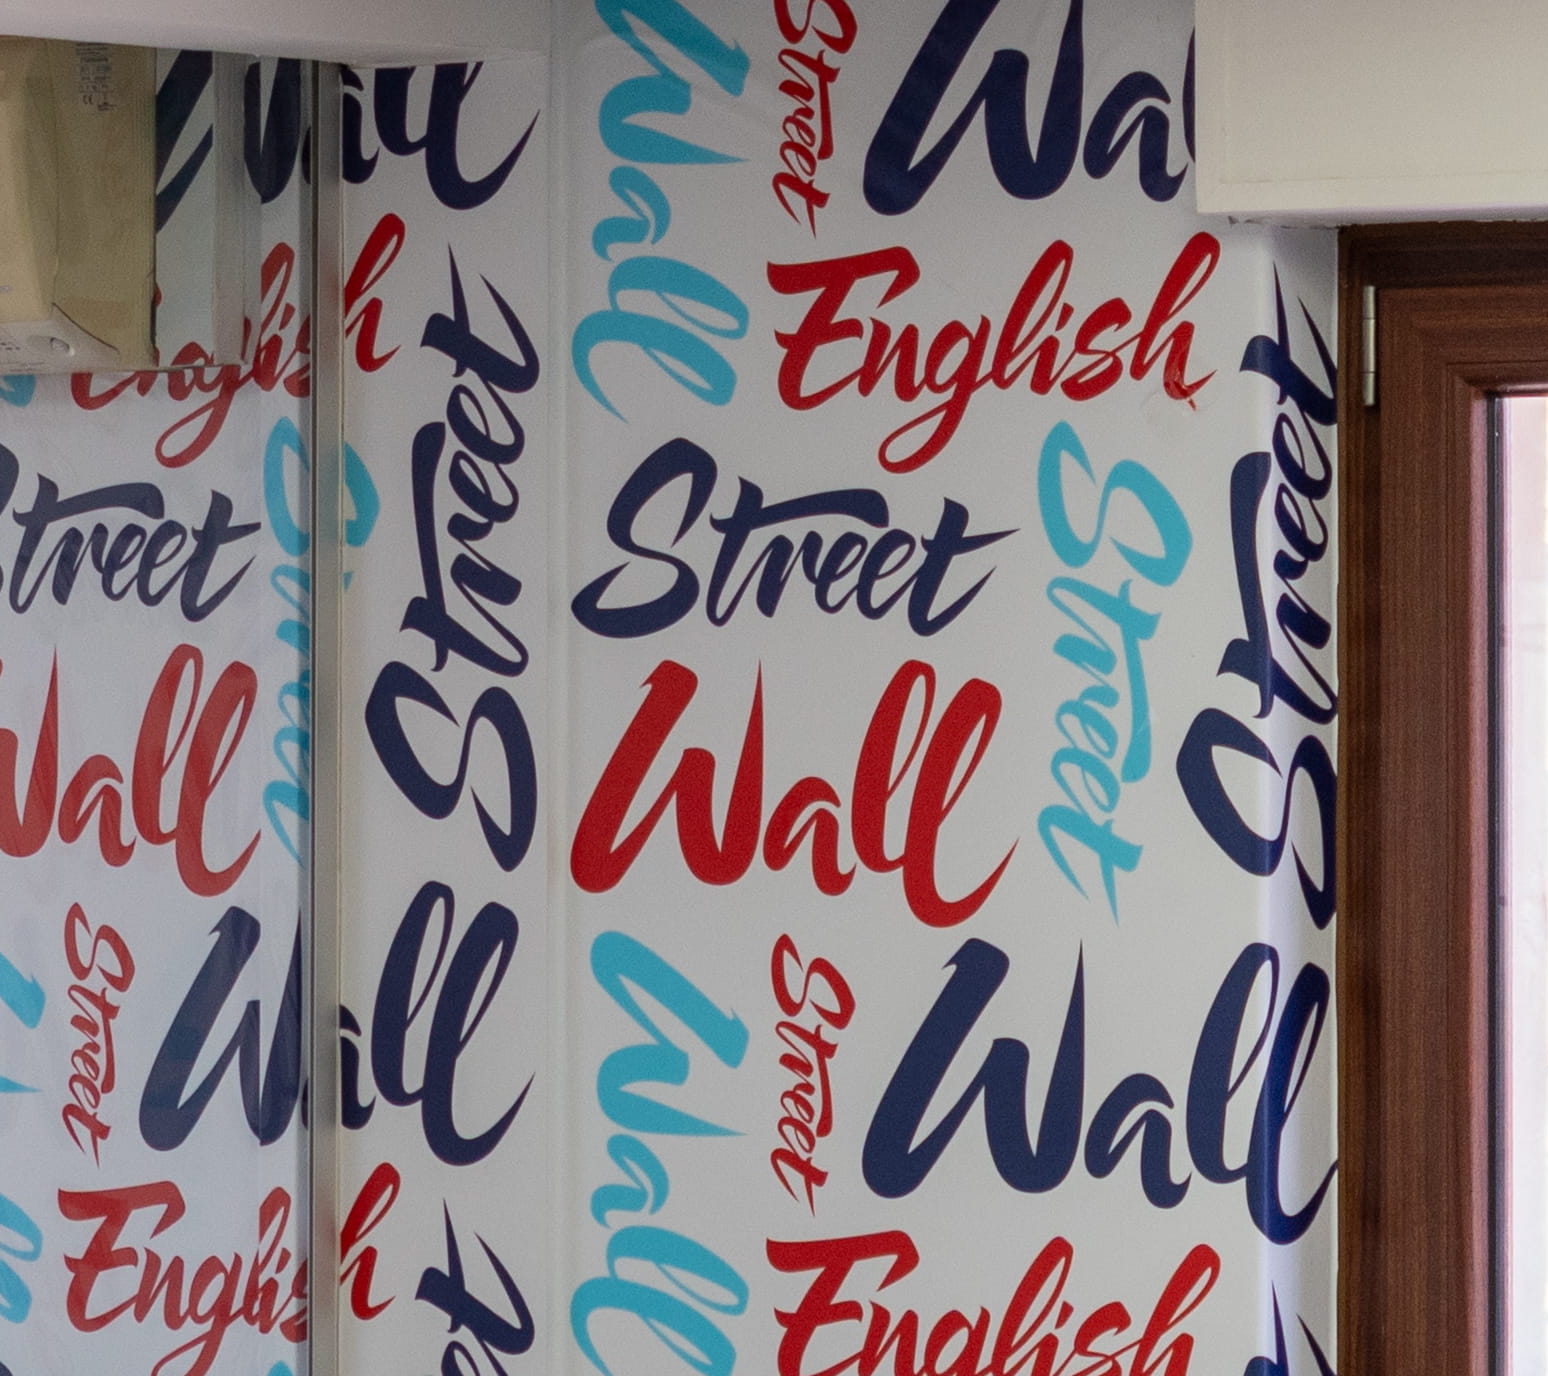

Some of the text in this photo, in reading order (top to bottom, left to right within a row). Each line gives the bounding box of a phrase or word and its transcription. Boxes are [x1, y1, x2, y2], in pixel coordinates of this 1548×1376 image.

[571, 0, 752, 424] Wall
[767, 231, 1222, 474] English
[364, 243, 541, 873] Street
[570, 437, 1020, 639] Street
[1036, 420, 1194, 926] Street
[1175, 260, 1337, 932] Street
[570, 659, 1019, 929] Wall
[64, 901, 136, 1168] Street
[770, 932, 856, 1217] Street
[861, 937, 1337, 1246] Wall
